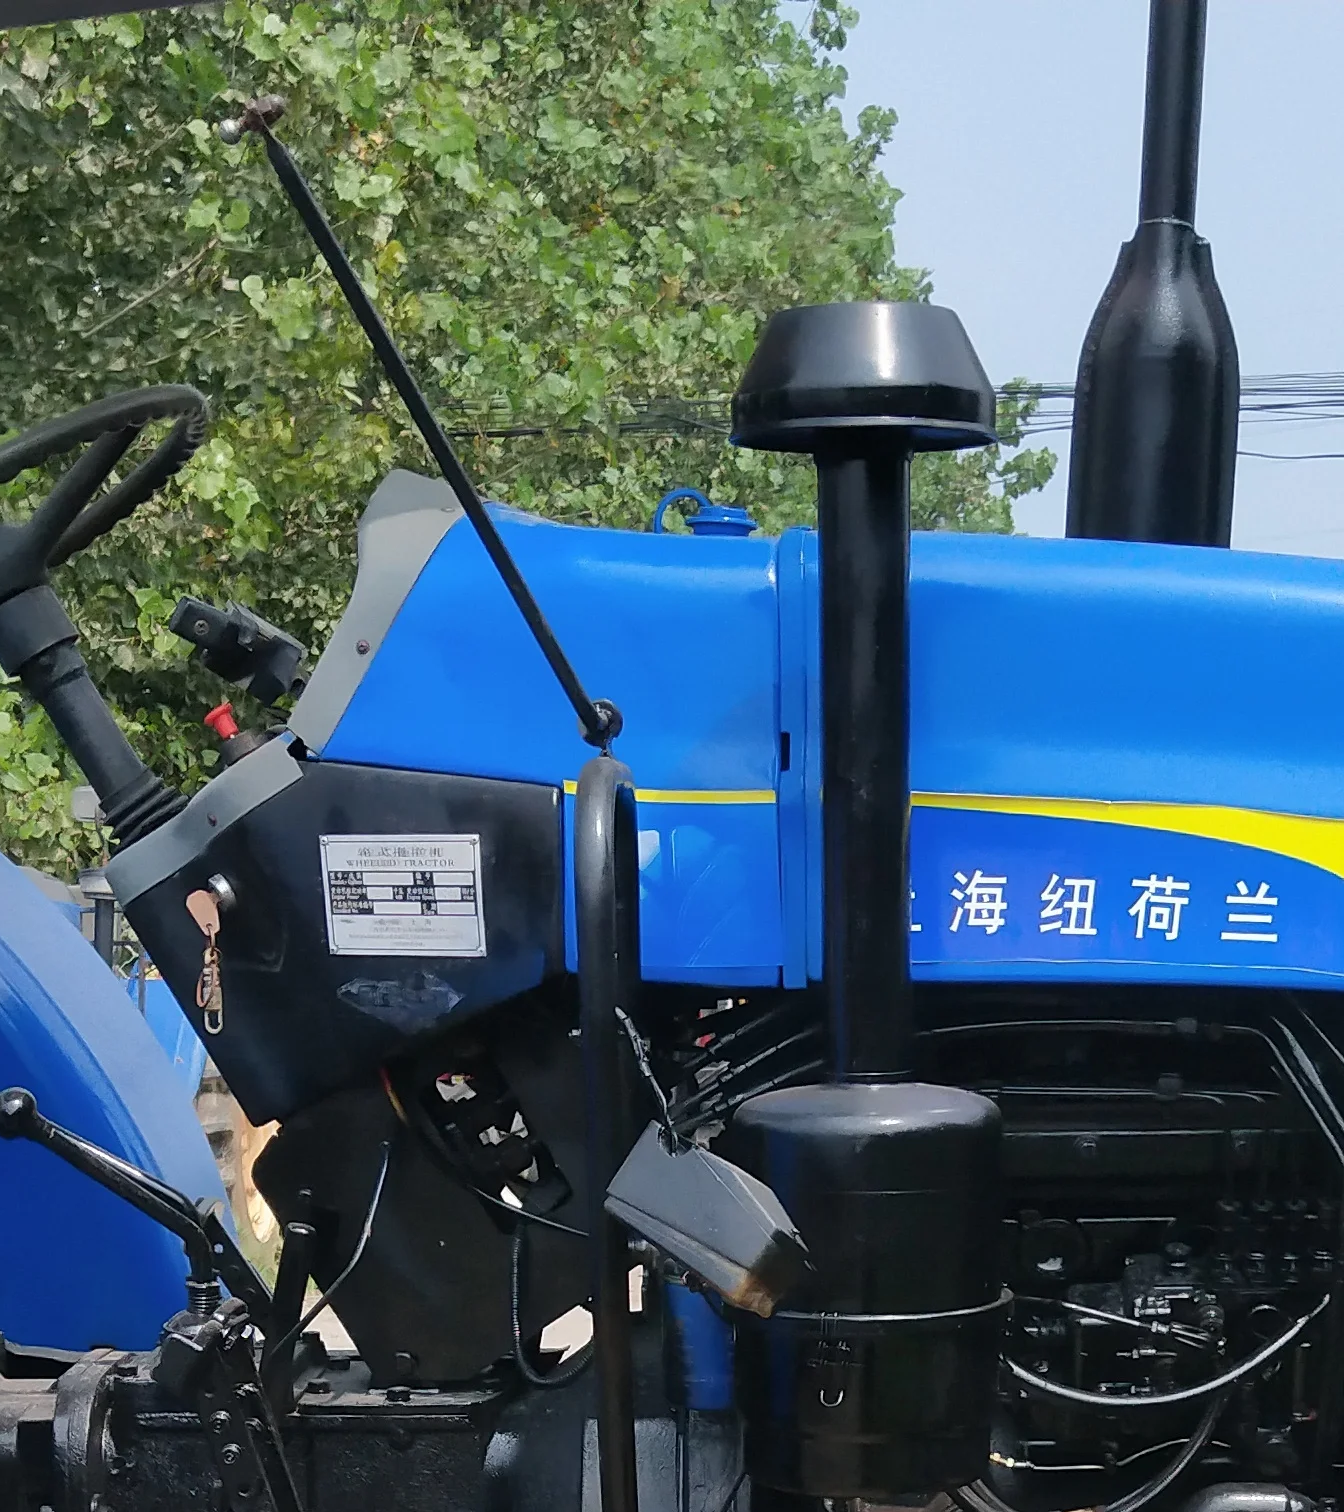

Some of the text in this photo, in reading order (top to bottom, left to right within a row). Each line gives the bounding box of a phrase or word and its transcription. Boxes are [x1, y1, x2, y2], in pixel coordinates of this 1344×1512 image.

[403, 858, 455, 868] TRACTOR
[911, 870, 1278, 942] 海纽荷兰
